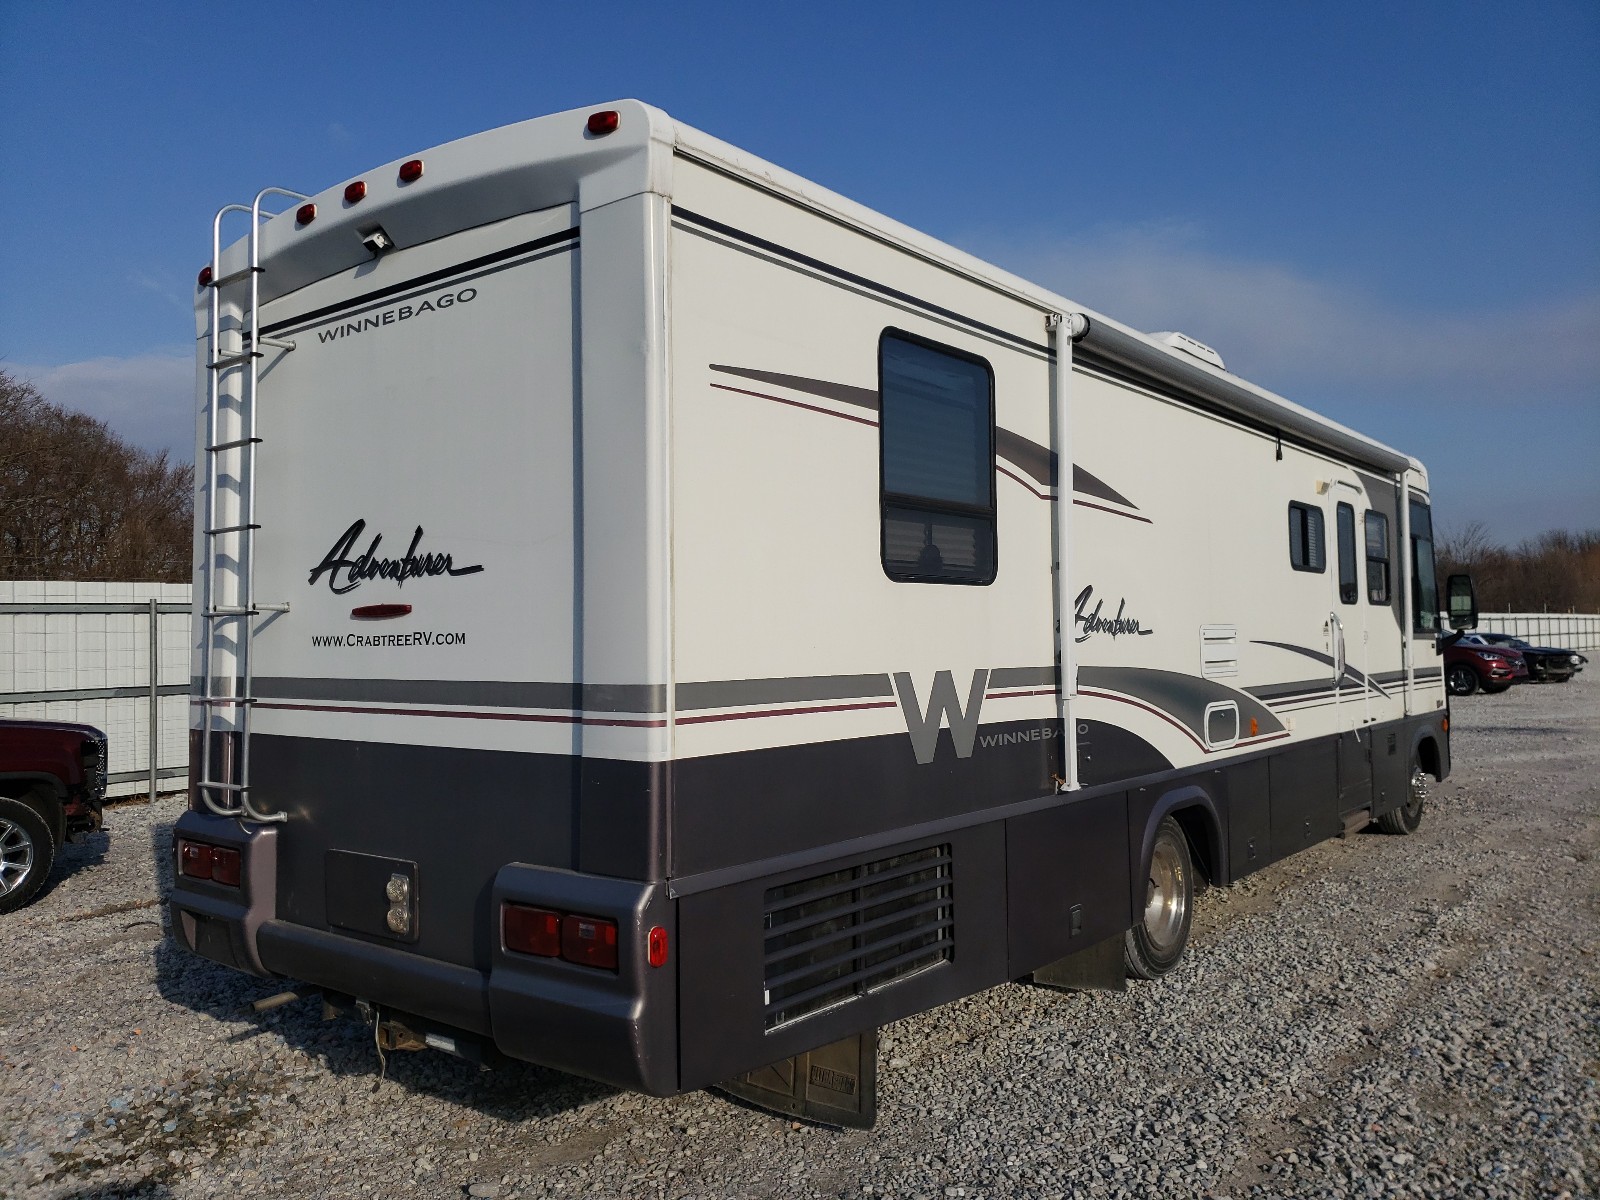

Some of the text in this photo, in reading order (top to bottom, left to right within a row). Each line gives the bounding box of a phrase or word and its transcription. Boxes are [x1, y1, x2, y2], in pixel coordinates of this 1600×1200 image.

[317, 287, 478, 344] WINNEBAGO
[308, 518, 484, 595] Adventurer
[893, 669, 989, 764] W
[979, 723, 1089, 748] WINNEBAO
